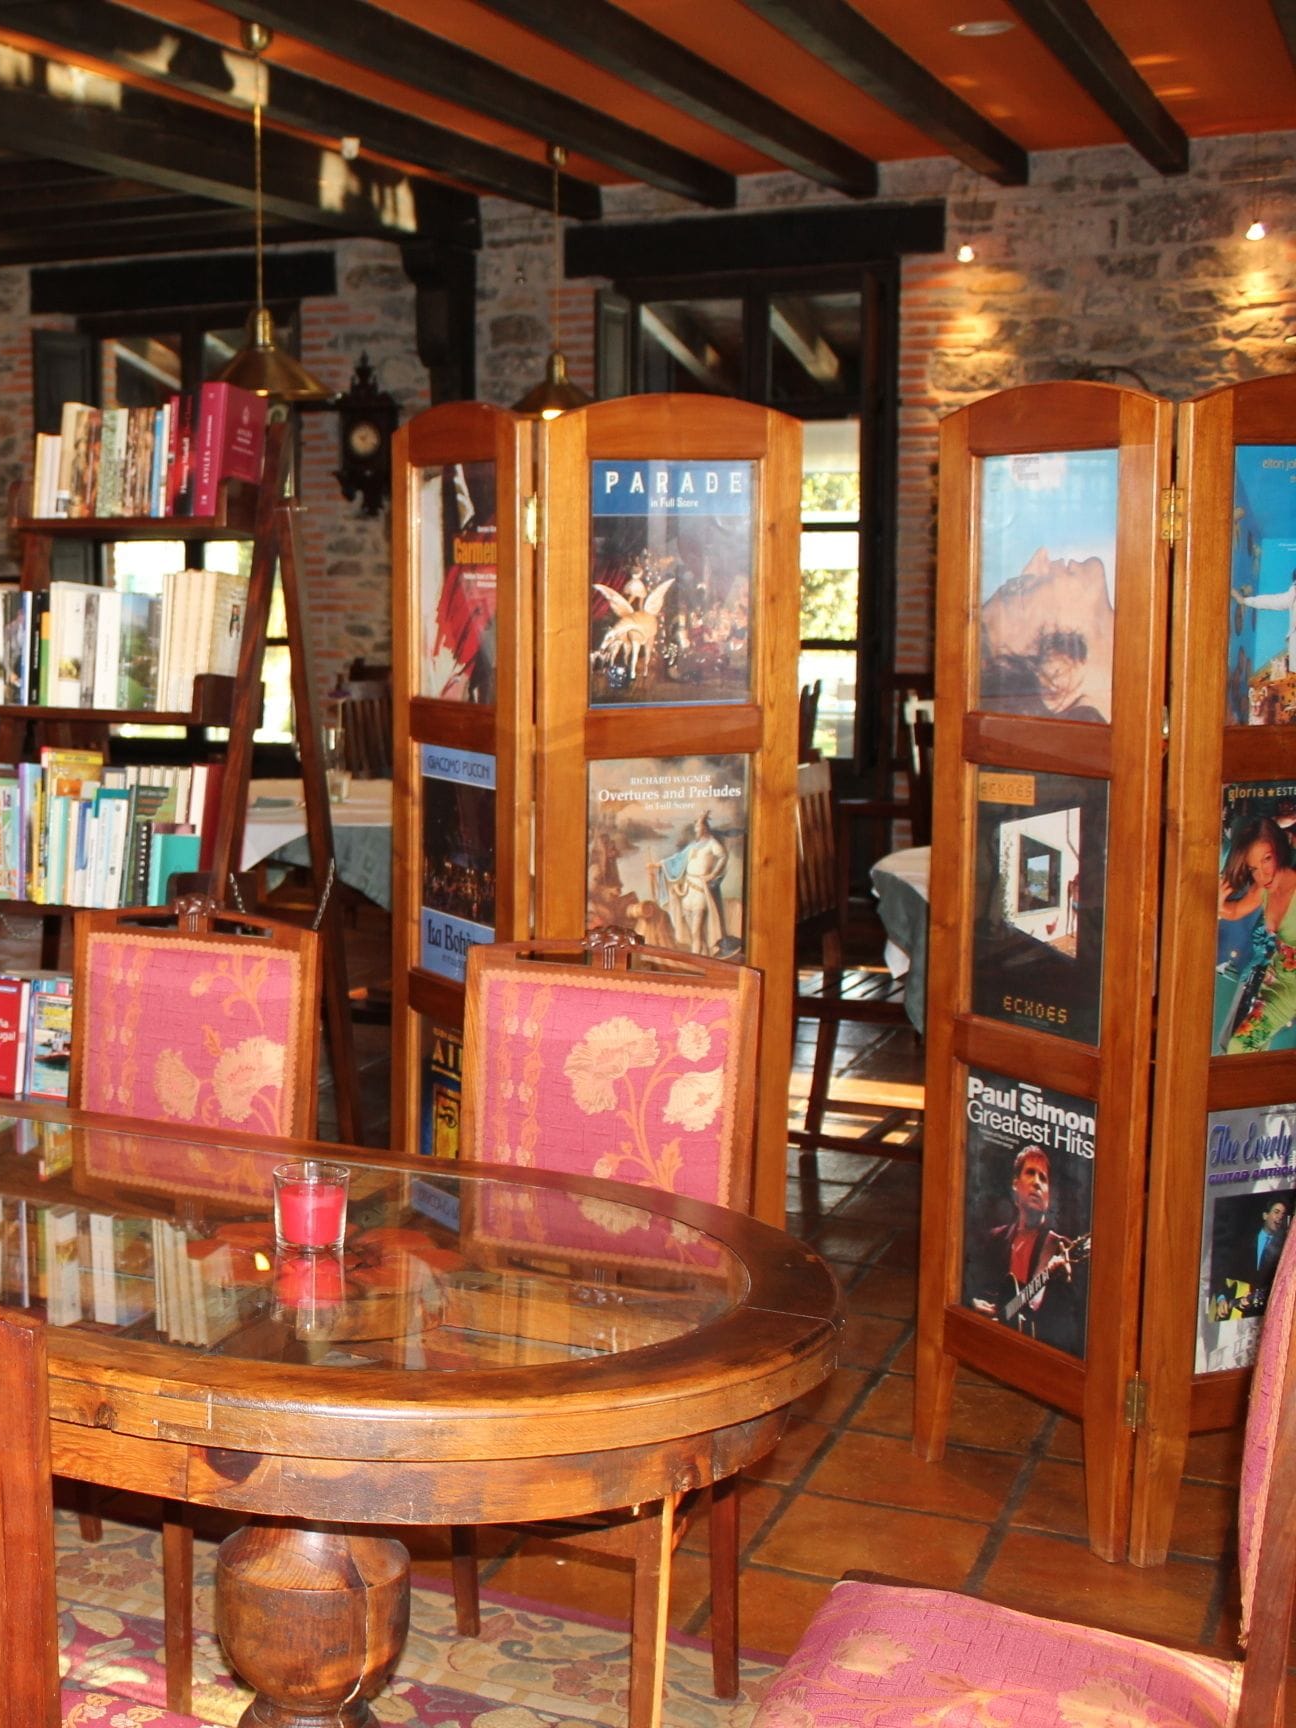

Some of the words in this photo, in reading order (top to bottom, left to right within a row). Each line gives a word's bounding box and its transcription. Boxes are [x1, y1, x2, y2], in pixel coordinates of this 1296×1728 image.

[605, 471, 743, 494] PARADE
[650, 498, 659, 508] in
[660, 497, 675, 508] Full
[677, 497, 699, 508] Score
[630, 776, 671, 785] RICHARD
[674, 775, 711, 784] WAGNER
[598, 789, 659, 802] Overtures
[663, 786, 685, 799] and
[689, 784, 742, 799] Preludes
[1228, 786, 1264, 802] gloria
[1003, 995, 1068, 1024] ECHOES
[967, 1076, 1017, 1111] Paul
[1020, 1092, 1095, 1136] Simon
[967, 1099, 1050, 1145] Greatest
[1054, 1125, 1095, 1159] Hits
[1209, 1125, 1240, 1168] The
[1208, 1169, 1250, 1186] GUITAR
